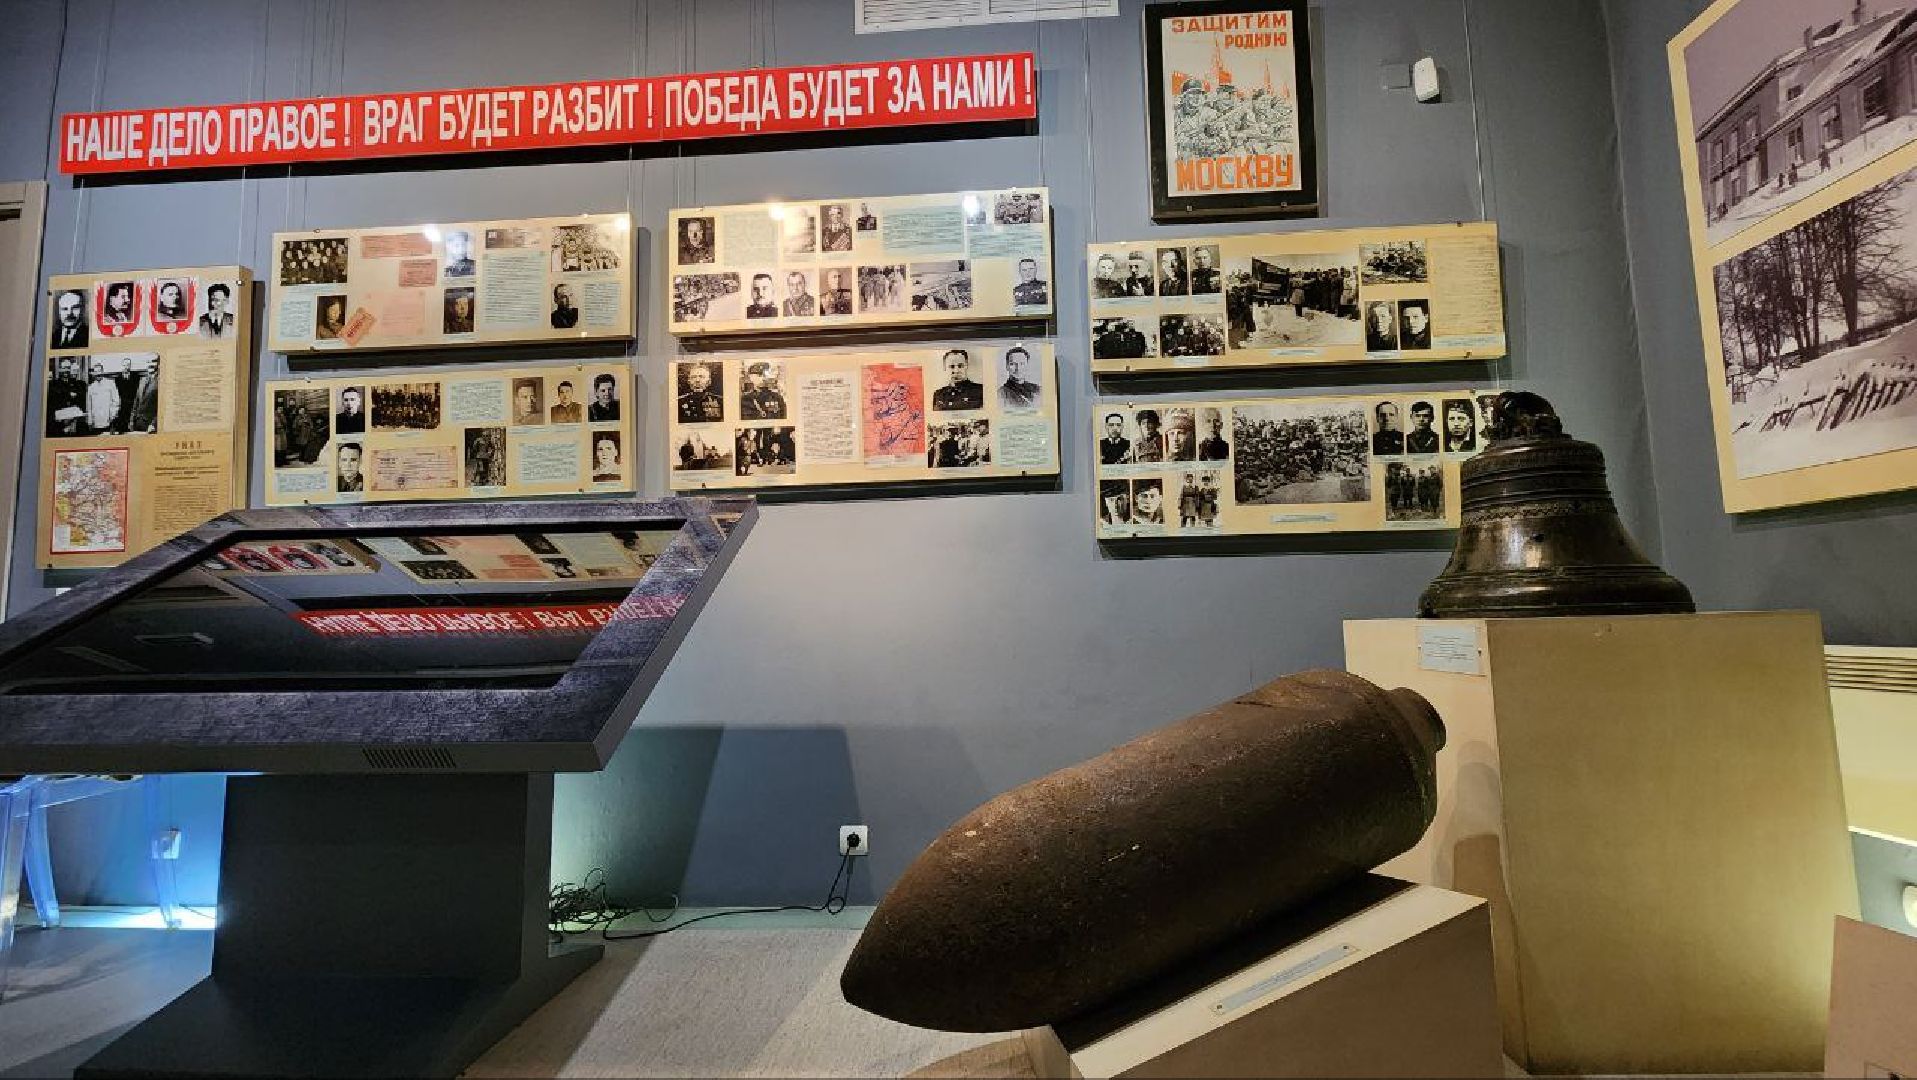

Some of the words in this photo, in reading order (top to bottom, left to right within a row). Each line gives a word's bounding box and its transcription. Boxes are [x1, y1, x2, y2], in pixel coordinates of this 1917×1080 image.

[1171, 12, 1287, 33] ЗАЩИТИМ
[1224, 31, 1288, 49] РОДНУЮ
[67, 113, 144, 162] НАШЕ
[148, 109, 222, 166] ДЕЛО
[364, 96, 433, 146] ВРАГ
[439, 90, 527, 147] БУДЕТ
[665, 74, 782, 131] ПОБЕДА
[788, 67, 880, 126] БУДЕТ
[887, 64, 927, 114] ЗА
[1176, 154, 1294, 192] МОСКВУ
